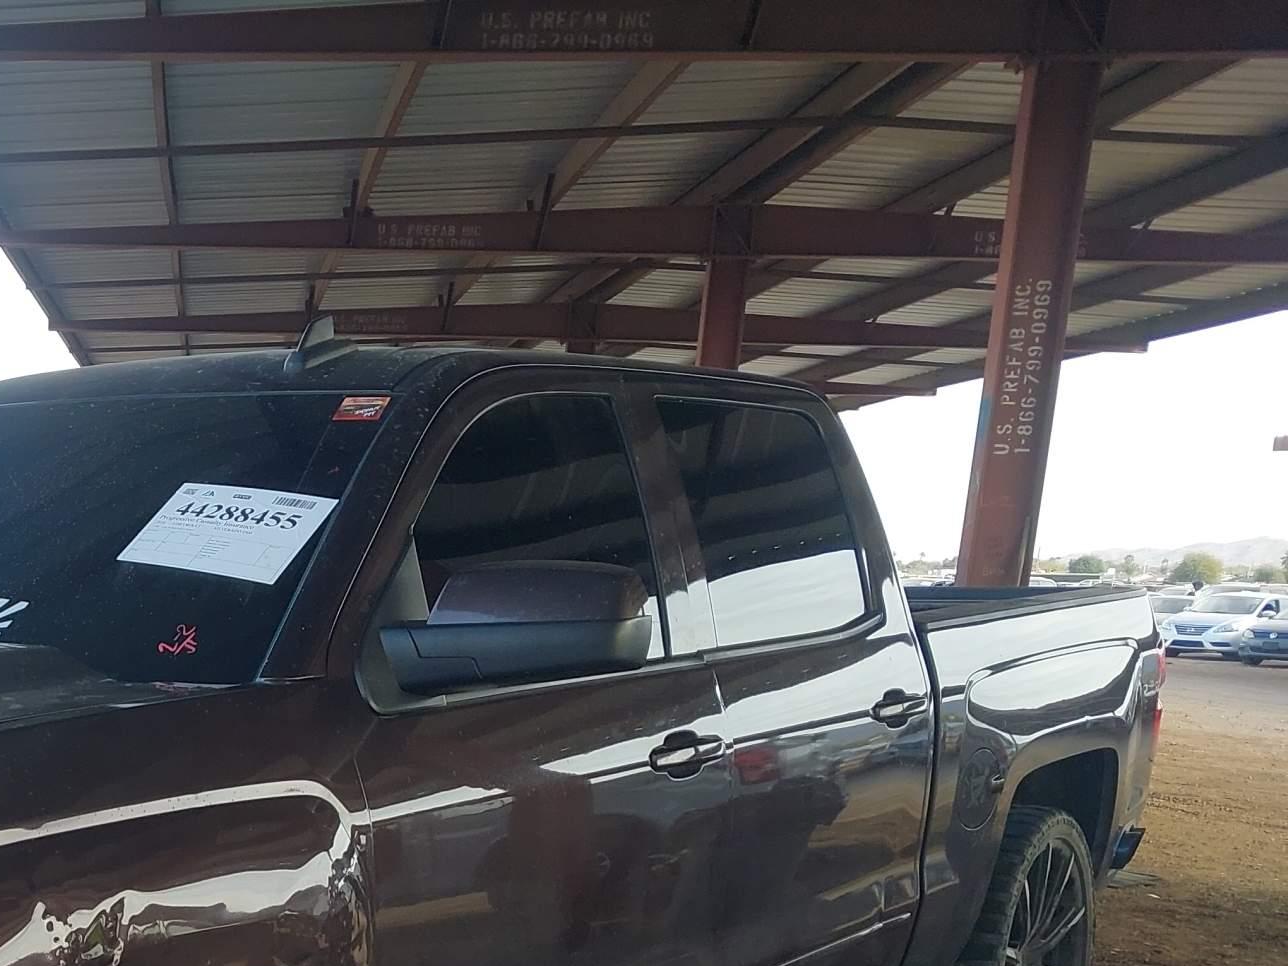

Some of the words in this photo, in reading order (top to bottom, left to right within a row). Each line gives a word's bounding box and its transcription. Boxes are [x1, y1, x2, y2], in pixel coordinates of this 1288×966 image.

[1013, 277, 1033, 316] INC.
[1000, 327, 1026, 406] PREFAB
[1014, 279, 1053, 454] 1-866-799-0969
[993, 417, 1014, 456] U.S.
[175, 501, 304, 530] 44288455
